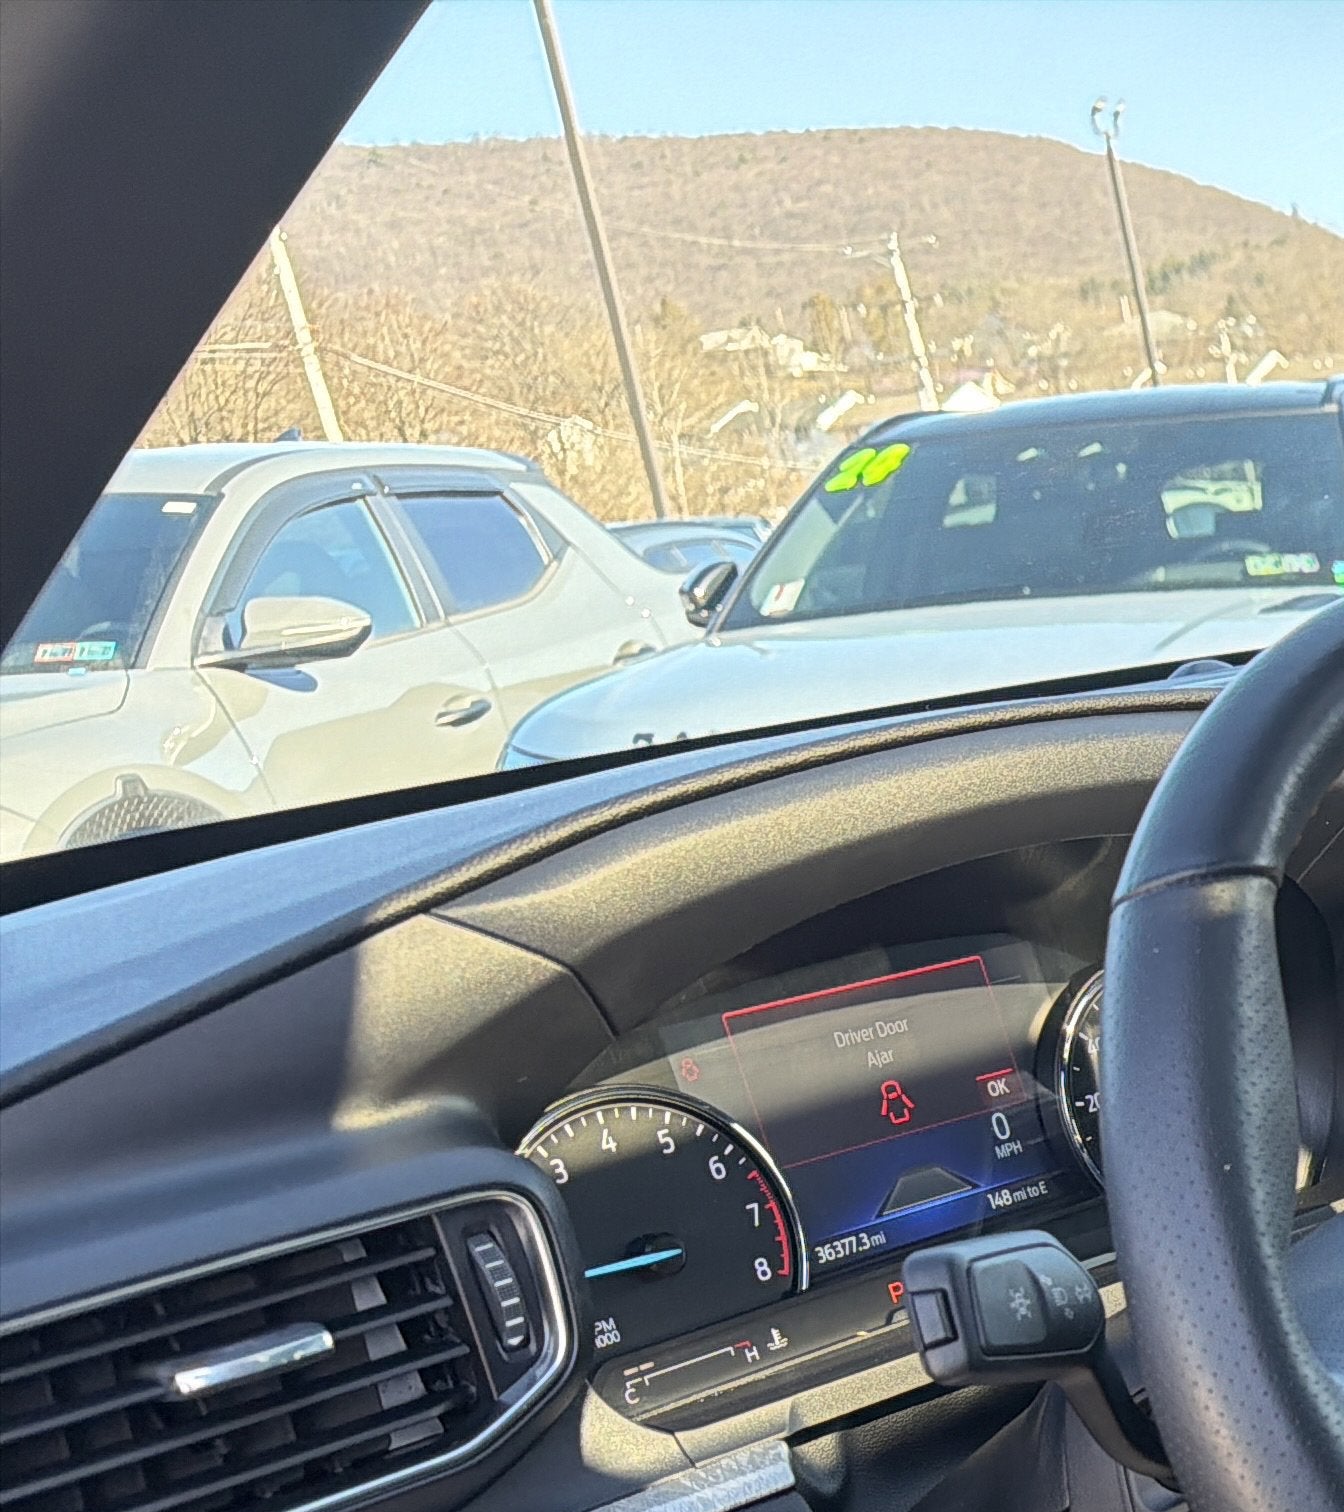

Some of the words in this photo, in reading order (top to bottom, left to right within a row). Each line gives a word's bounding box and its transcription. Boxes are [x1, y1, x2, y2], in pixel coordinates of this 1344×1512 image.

[833, 1024, 874, 1048] Driver
[875, 1018, 909, 1038] Door
[866, 1047, 895, 1069] Ajar
[987, 1077, 1011, 1097] OK
[991, 1112, 1011, 1140] 0
[601, 1128, 617, 1153] 4
[657, 1129, 675, 1154] 5
[994, 1140, 1022, 1160] MPH
[549, 1158, 569, 1184] 3
[708, 1155, 727, 1180] 6
[745, 1202, 760, 1227] 7
[754, 1257, 772, 1281] 8
[888, 1281, 904, 1303] P
[594, 1317, 617, 1335] PM
[744, 1347, 760, 1363] H
[624, 1387, 640, 1405] C
